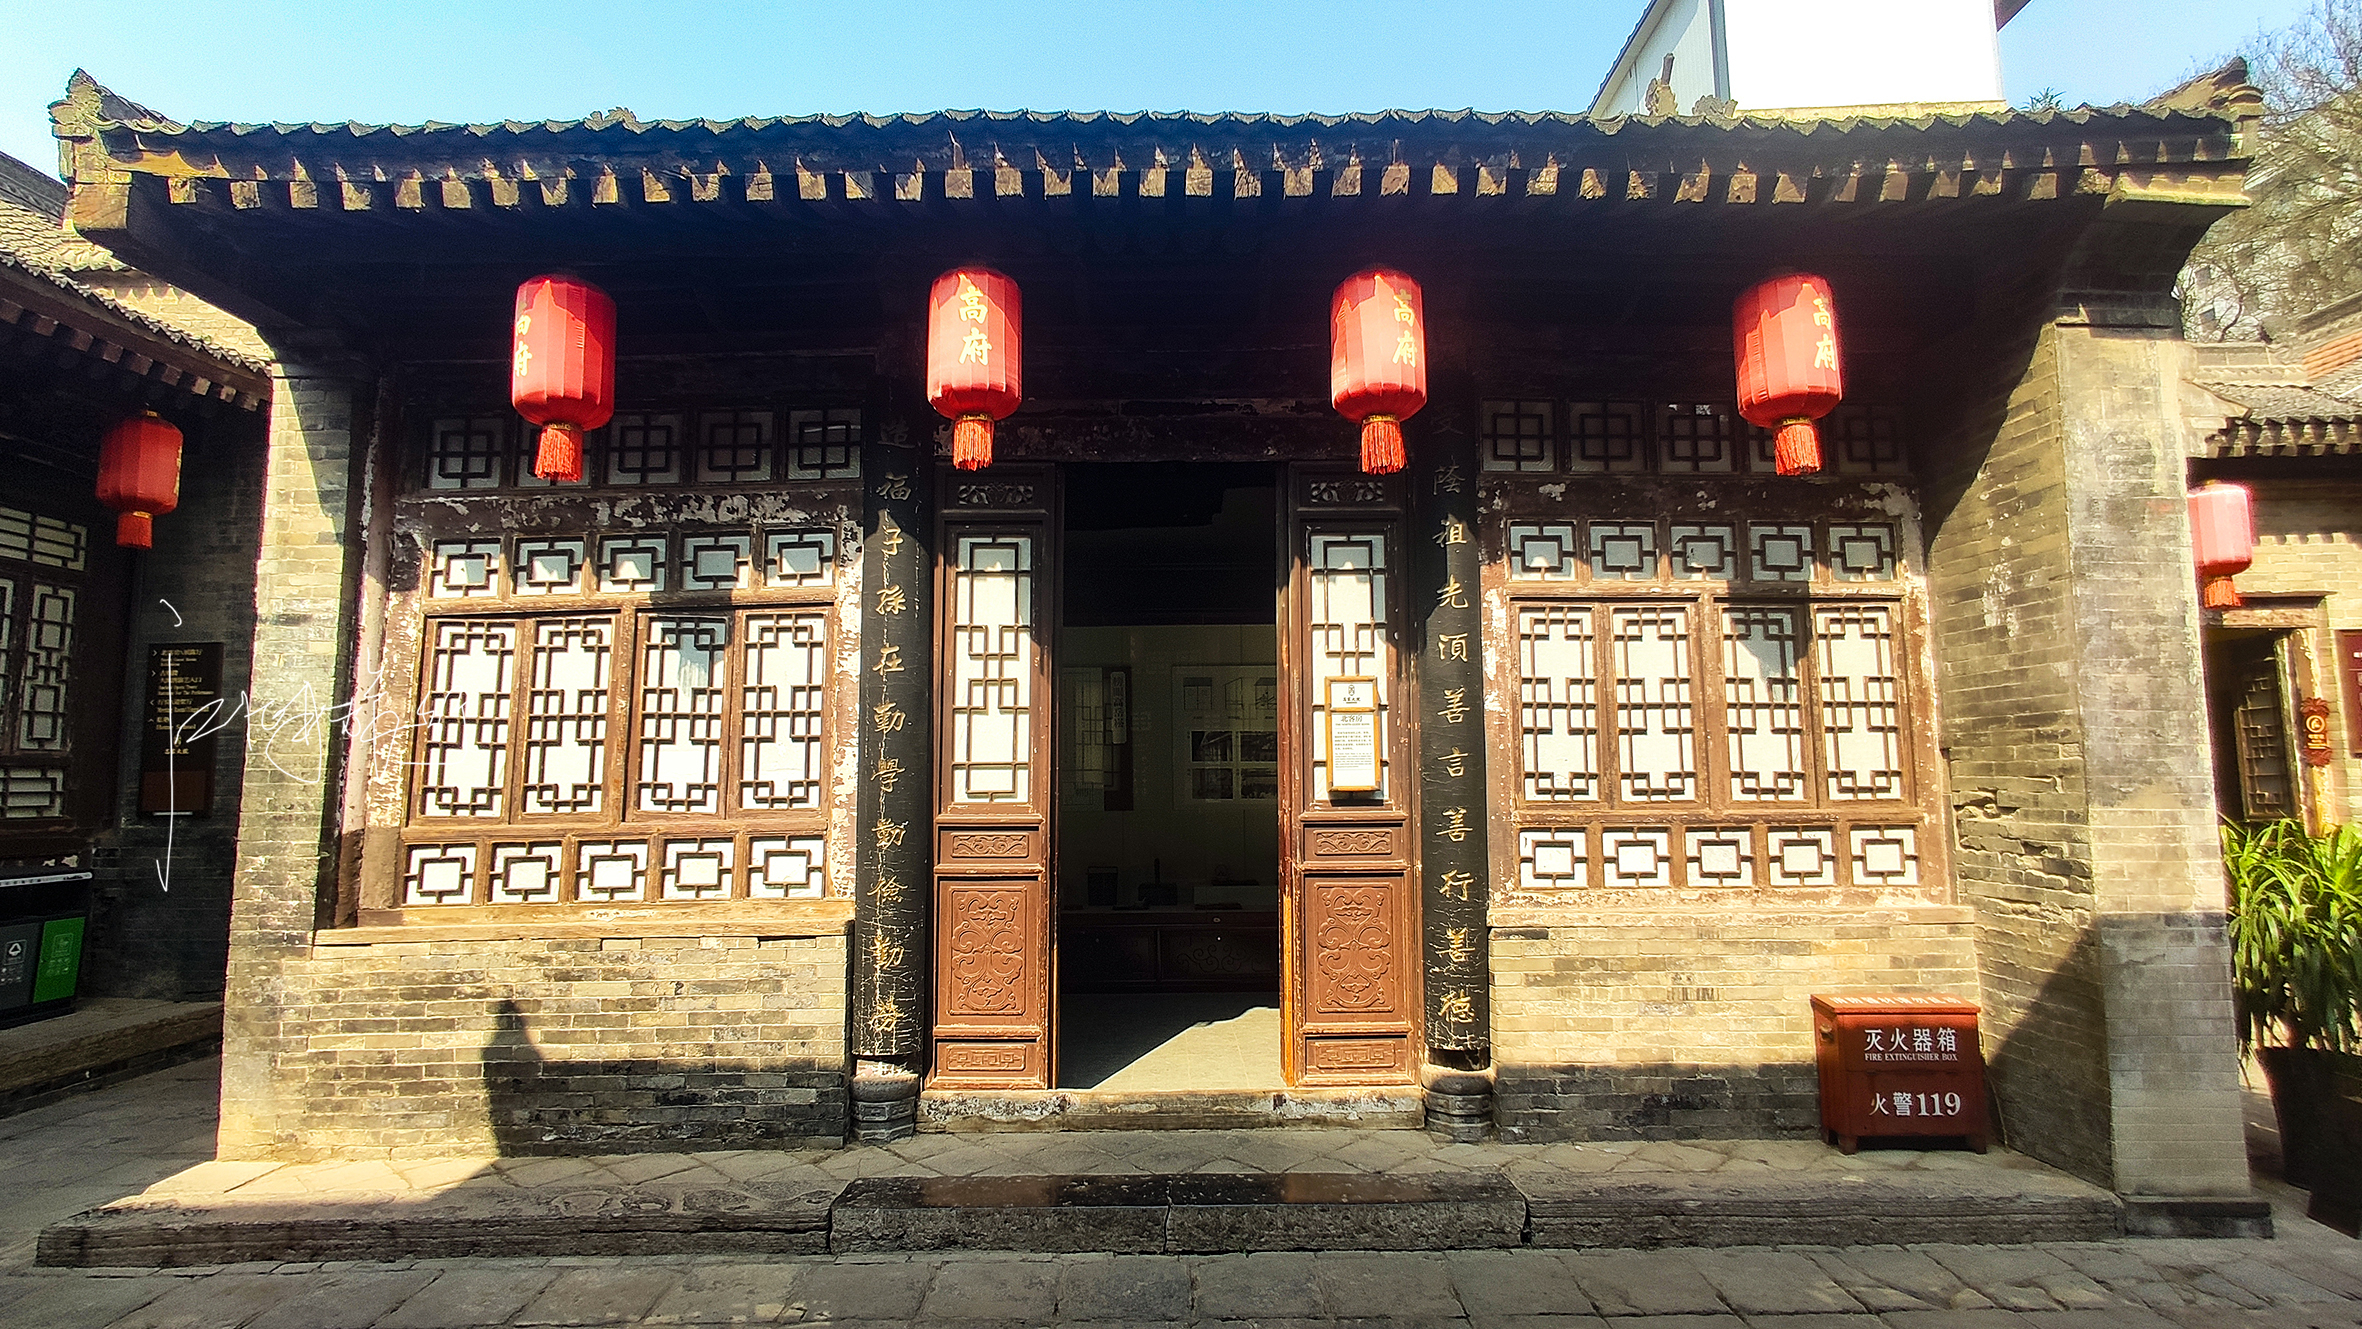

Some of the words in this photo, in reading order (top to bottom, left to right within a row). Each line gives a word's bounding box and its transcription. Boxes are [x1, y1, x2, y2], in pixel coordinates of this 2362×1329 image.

[958, 285, 992, 366] 高府
[1392, 289, 1419, 369] 高府
[1812, 294, 1837, 373] 高府
[1864, 1027, 1956, 1052] 灭火器箱
[1865, 1053, 1882, 1061] FIRE
[1884, 1053, 1940, 1061] EXTINGUISHER
[1942, 1053, 1958, 1061] BOX
[1868, 1092, 1962, 1117] 火警119
